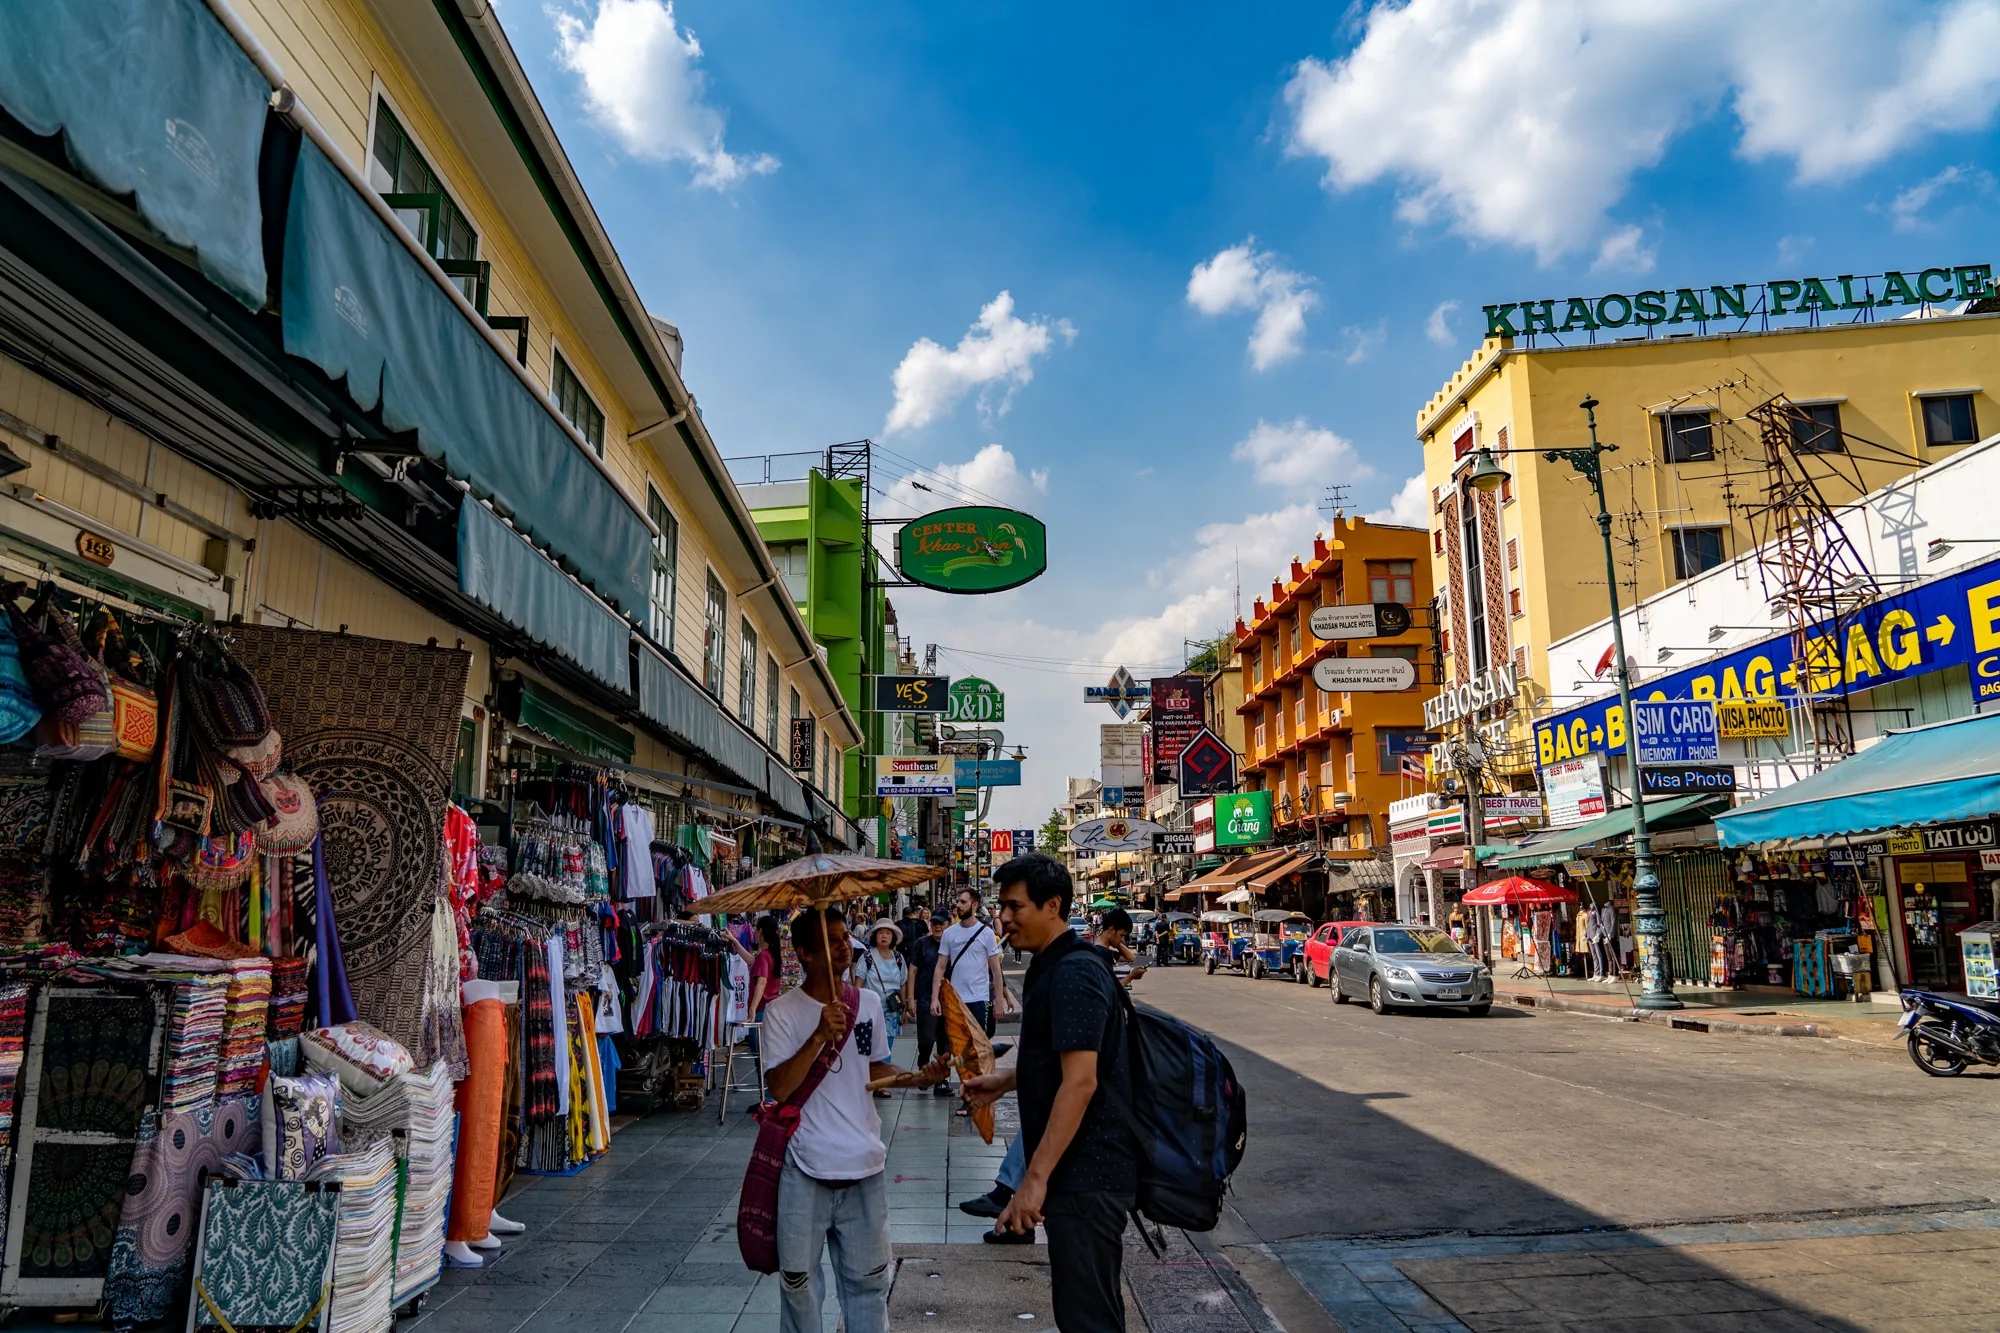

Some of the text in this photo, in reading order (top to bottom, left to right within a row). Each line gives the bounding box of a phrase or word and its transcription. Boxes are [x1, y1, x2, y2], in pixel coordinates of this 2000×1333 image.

[1482, 264, 1992, 339] KHAOSAN PALACE
[912, 523, 977, 538] CENTER
[85, 538, 113, 560] 142
[1314, 622, 1338, 631] KHAOSAN
[1339, 621, 1358, 629] PALACE
[1358, 620, 1375, 628] HOTEL
[1806, 609, 1922, 692] BAG
[895, 680, 928, 704] YES
[1423, 661, 1520, 731] KHAOSAN
[995, 695, 1003, 719] INN
[1167, 699, 1189, 709] LEO
[1638, 707, 1666, 735] SIM
[1670, 706, 1714, 734] CARD
[1720, 706, 1785, 729] VISA PHOTO
[1538, 717, 1590, 766] BAG
[1640, 747, 1676, 761] MEMORY
[1688, 745, 1717, 760] PHONE
[892, 762, 938, 770] Southeast
[1549, 761, 1584, 776] BEST TRAVEL
[1644, 771, 1732, 788] Visa Photo
[1485, 799, 1541, 808] BEST TRAVEL
[1228, 819, 1260, 835] Chang
[1924, 825, 1993, 849] TATTOO
[1892, 841, 1919, 851] PHOTO
[1830, 851, 1842, 860] SIM
